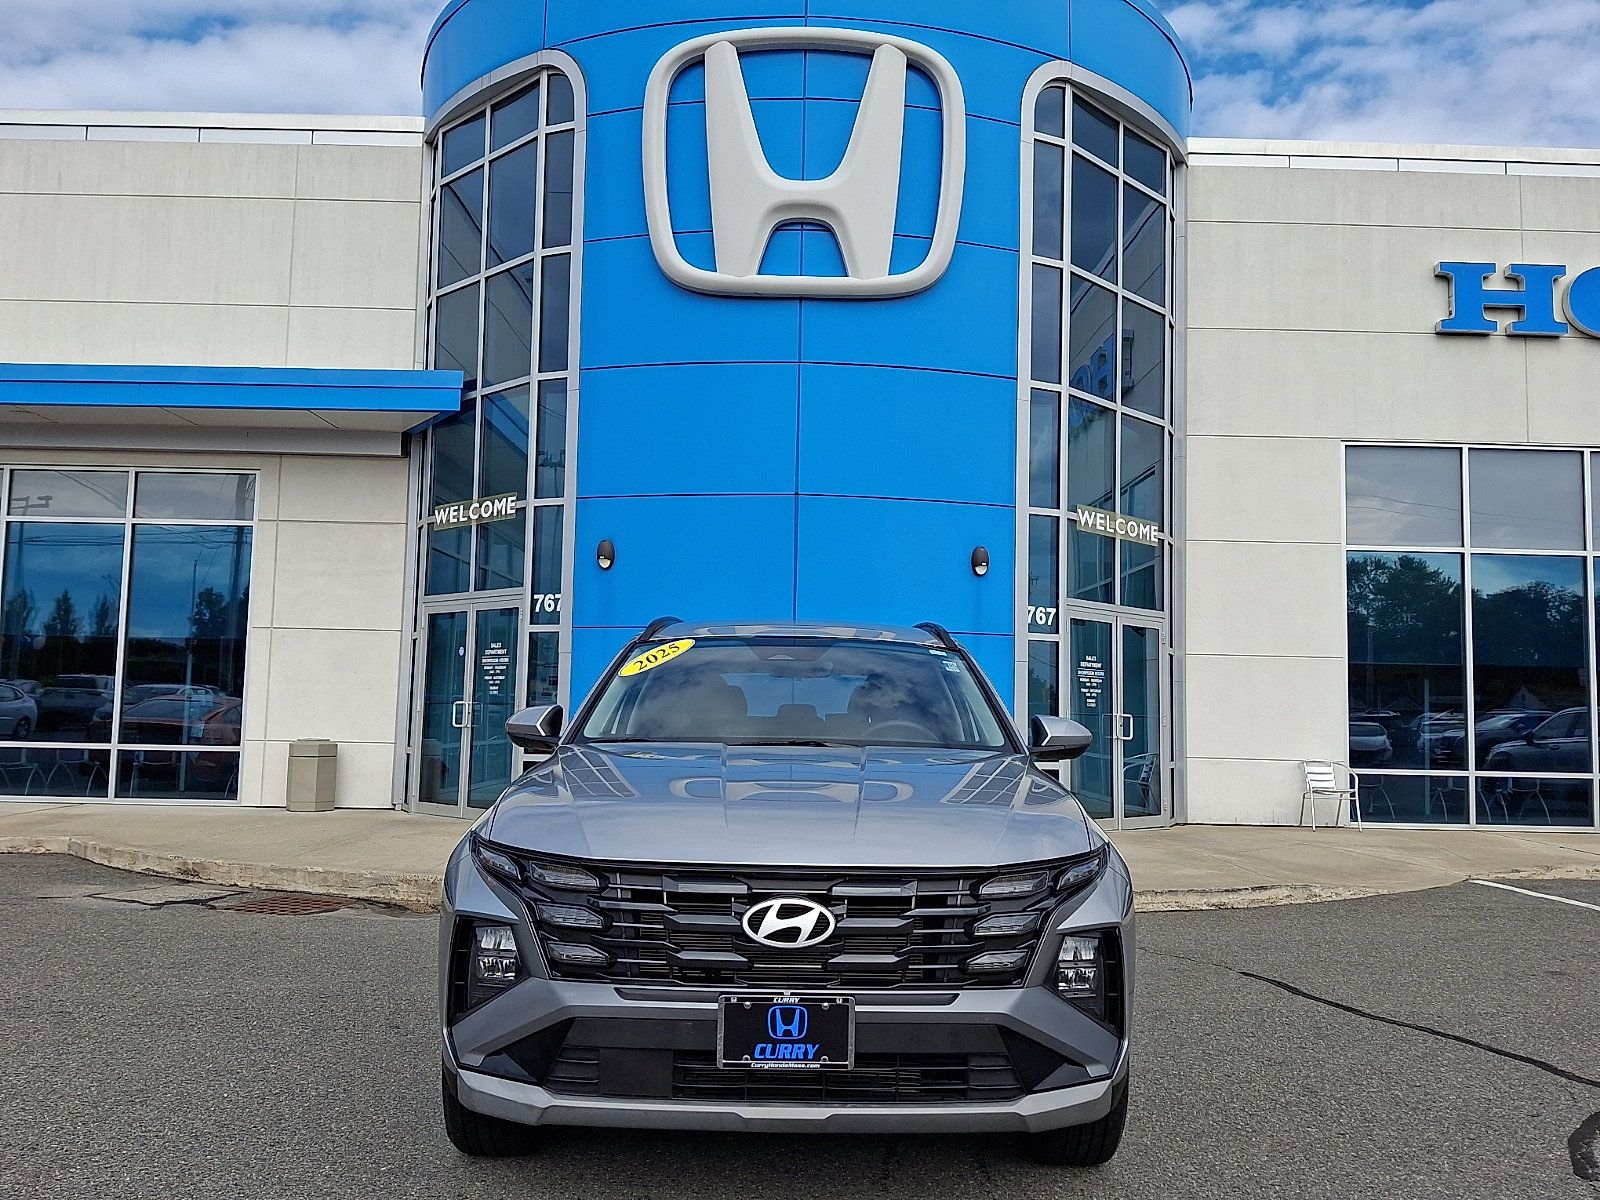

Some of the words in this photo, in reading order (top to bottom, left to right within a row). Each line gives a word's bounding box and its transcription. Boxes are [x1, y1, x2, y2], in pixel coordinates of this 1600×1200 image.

[435, 496, 517, 525] WELCOME
[1077, 508, 1159, 542] WELCOME
[533, 593, 561, 612] 767
[1027, 606, 1056, 625] 767
[633, 643, 680, 671] 2025
[754, 1043, 819, 1059] CURRY
